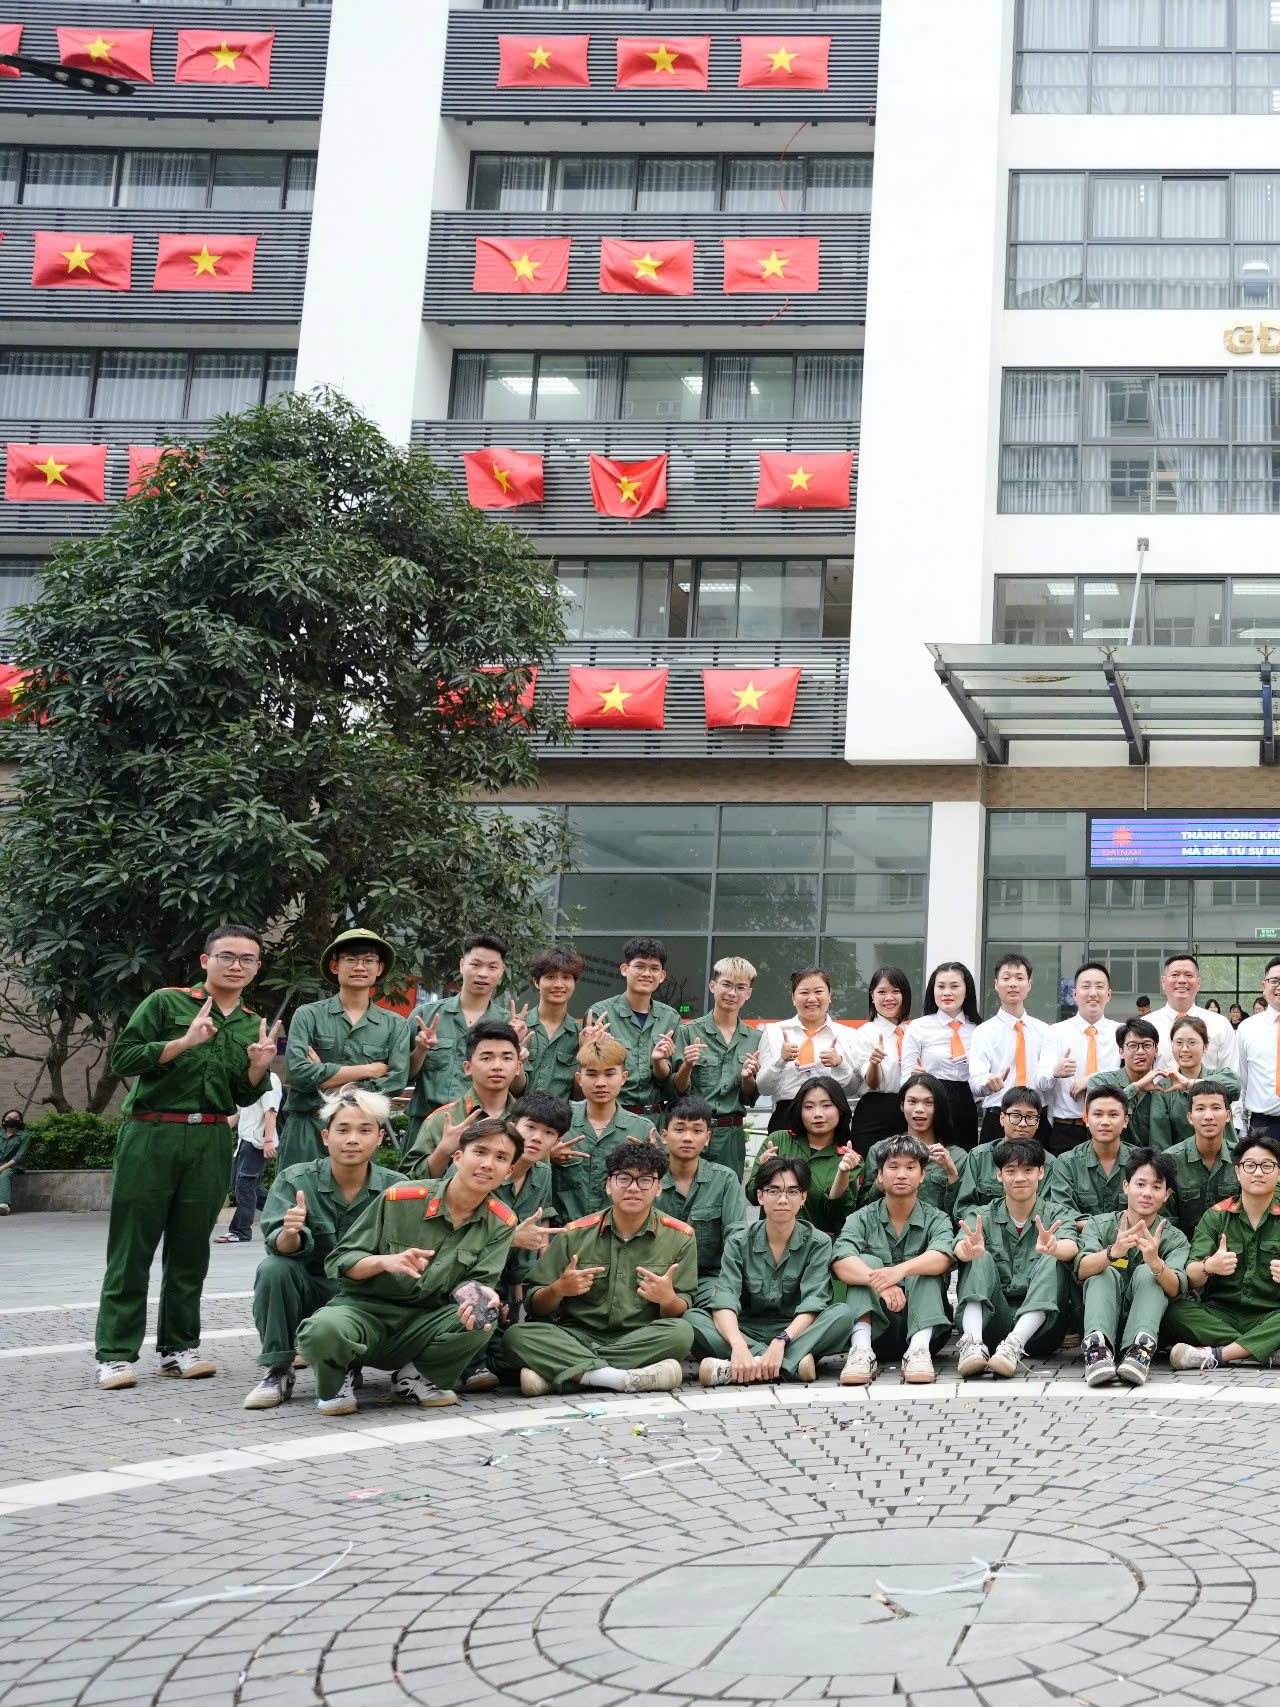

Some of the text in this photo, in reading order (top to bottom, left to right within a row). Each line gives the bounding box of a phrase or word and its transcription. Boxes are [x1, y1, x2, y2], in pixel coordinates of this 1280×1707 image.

[1181, 829, 1222, 840] THÀNH
[1224, 829, 1257, 840] CÔNG
[1182, 845, 1201, 856] MÀ
[1203, 845, 1228, 856] ĐẾN
[1230, 845, 1247, 856] TỪ
[1248, 845, 1265, 857] SỰ
